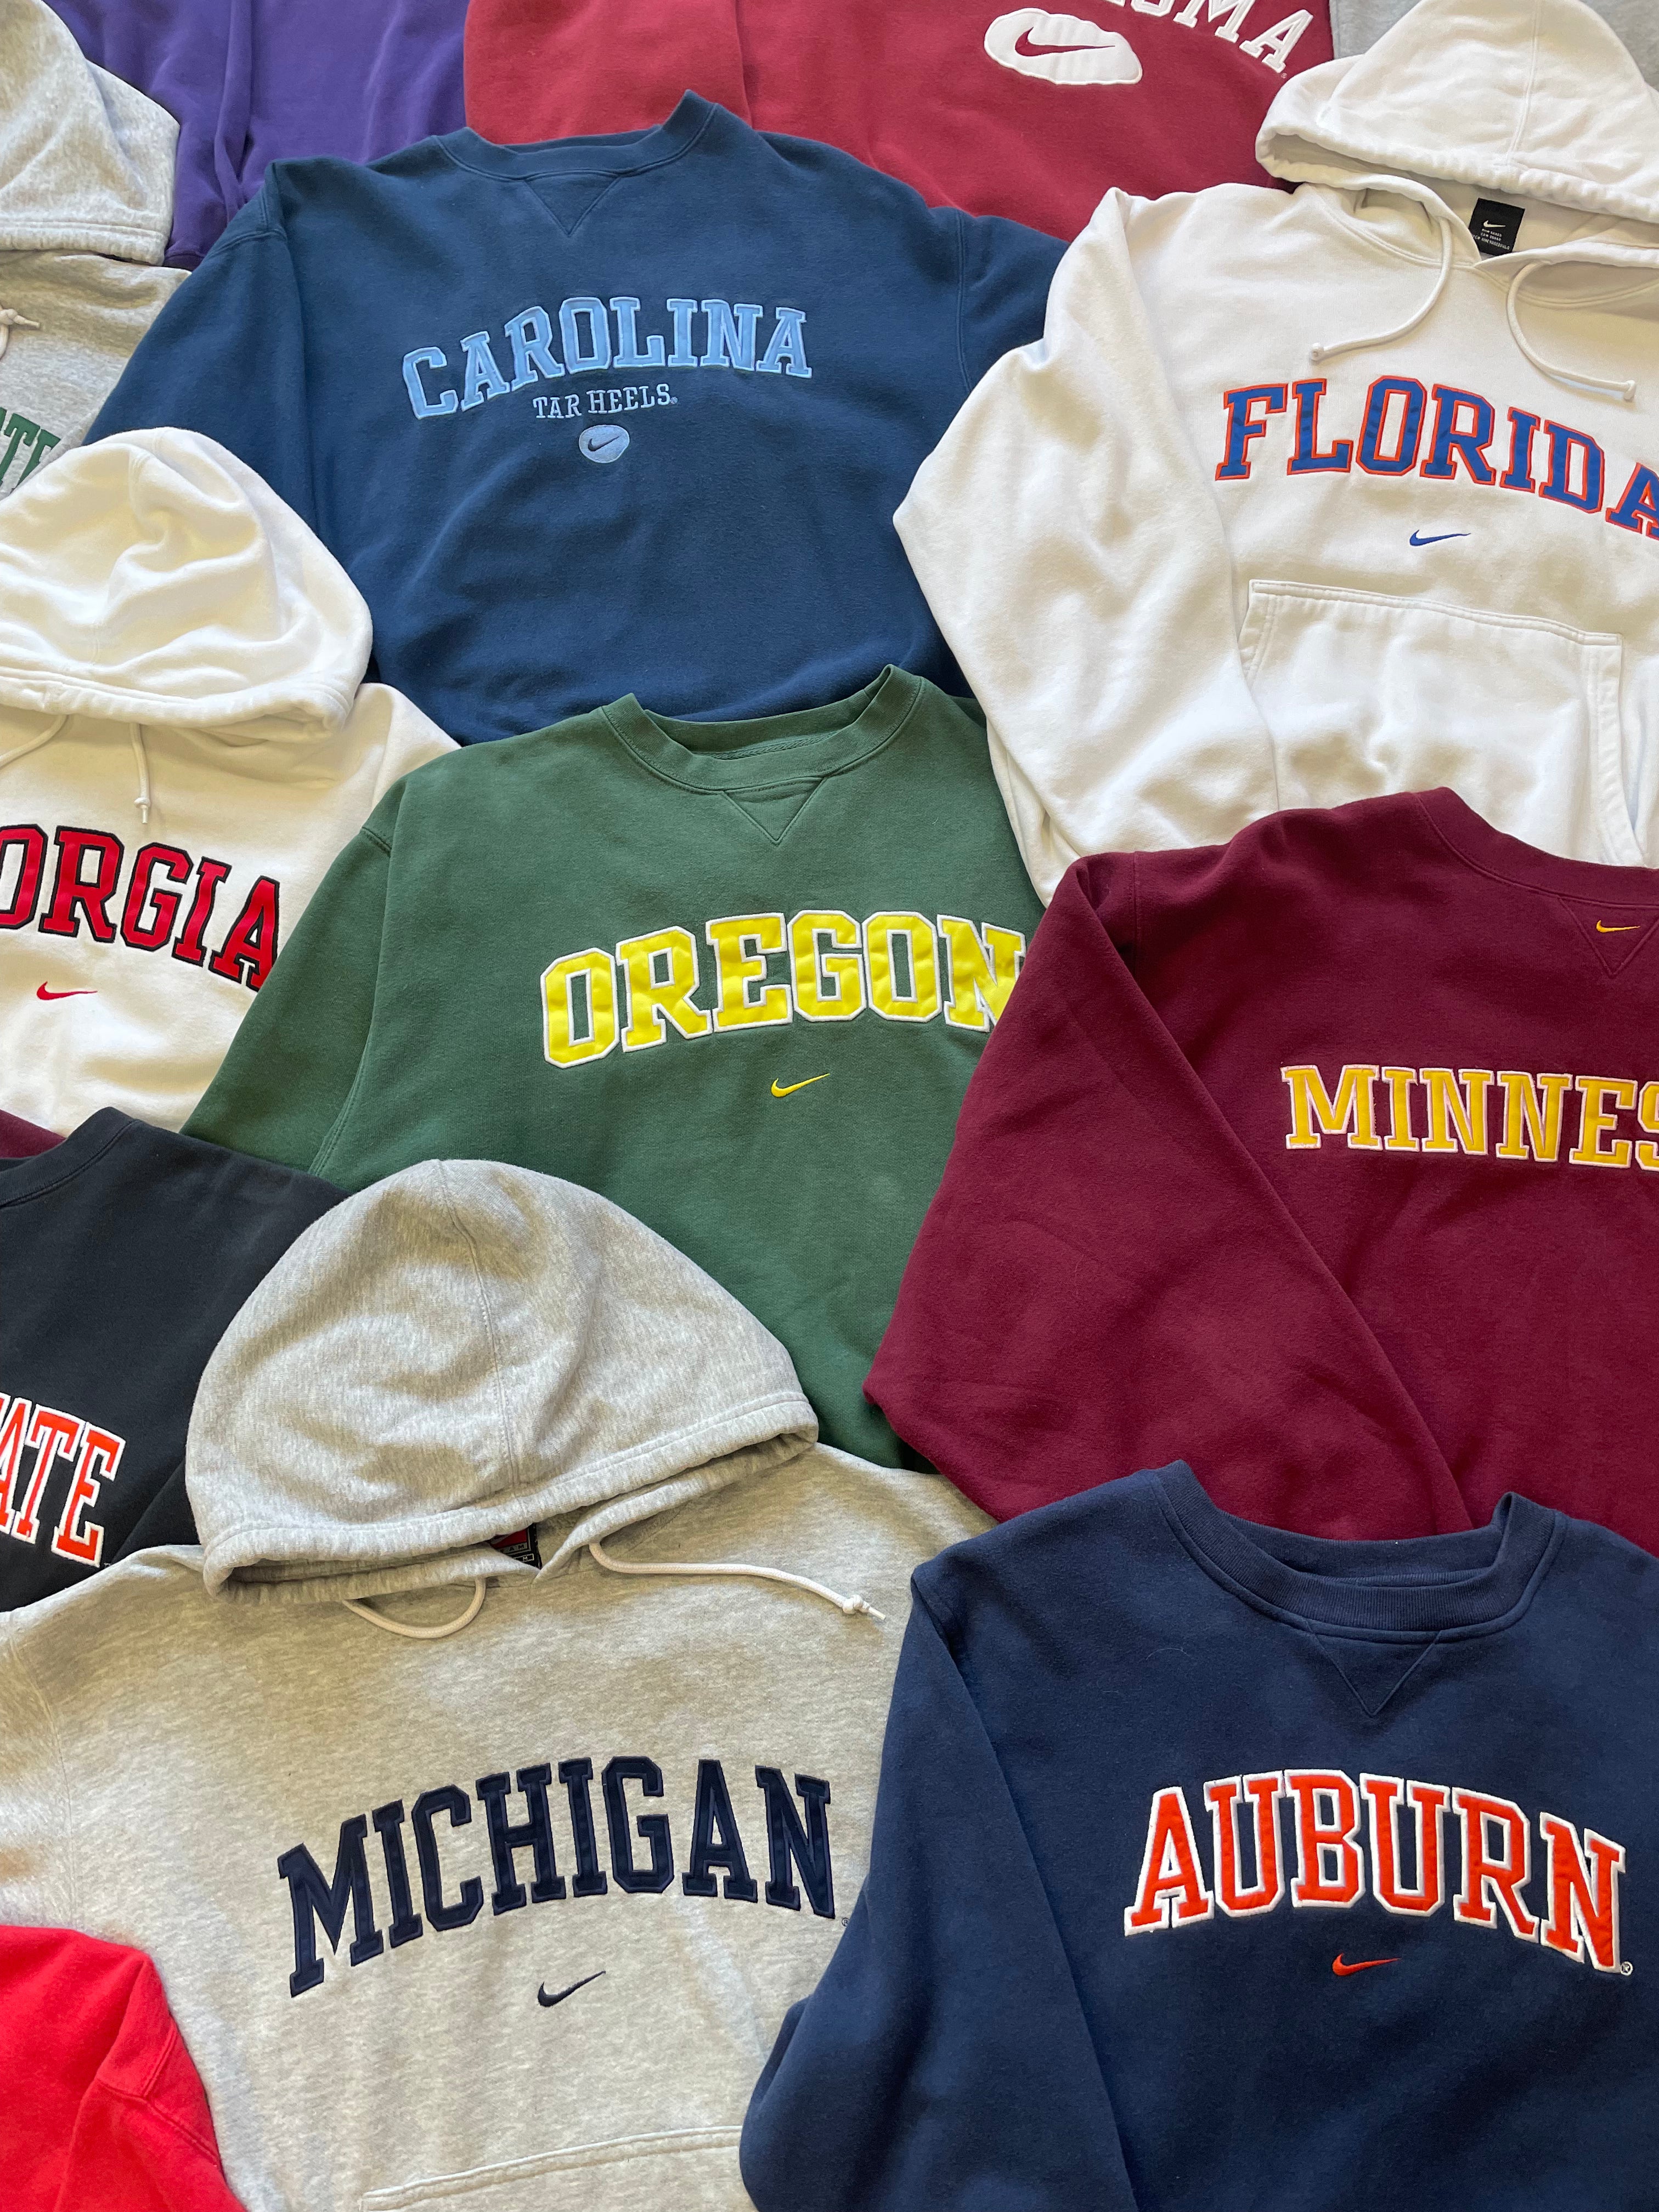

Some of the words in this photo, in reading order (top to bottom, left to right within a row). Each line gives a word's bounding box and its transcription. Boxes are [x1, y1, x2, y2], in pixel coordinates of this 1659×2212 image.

[402, 296, 812, 419] CAROLINA
[532, 394, 582, 419] TAR
[586, 383, 671, 414] HEELS
[1215, 375, 1659, 540] FLORIDA
[0, 824, 280, 992] ORGIA
[540, 910, 1026, 1068] OREGON
[0, 1392, 126, 1568] ATE
[278, 1756, 835, 1997] MICHIGAN
[1124, 1769, 1626, 1973] AUBURN
